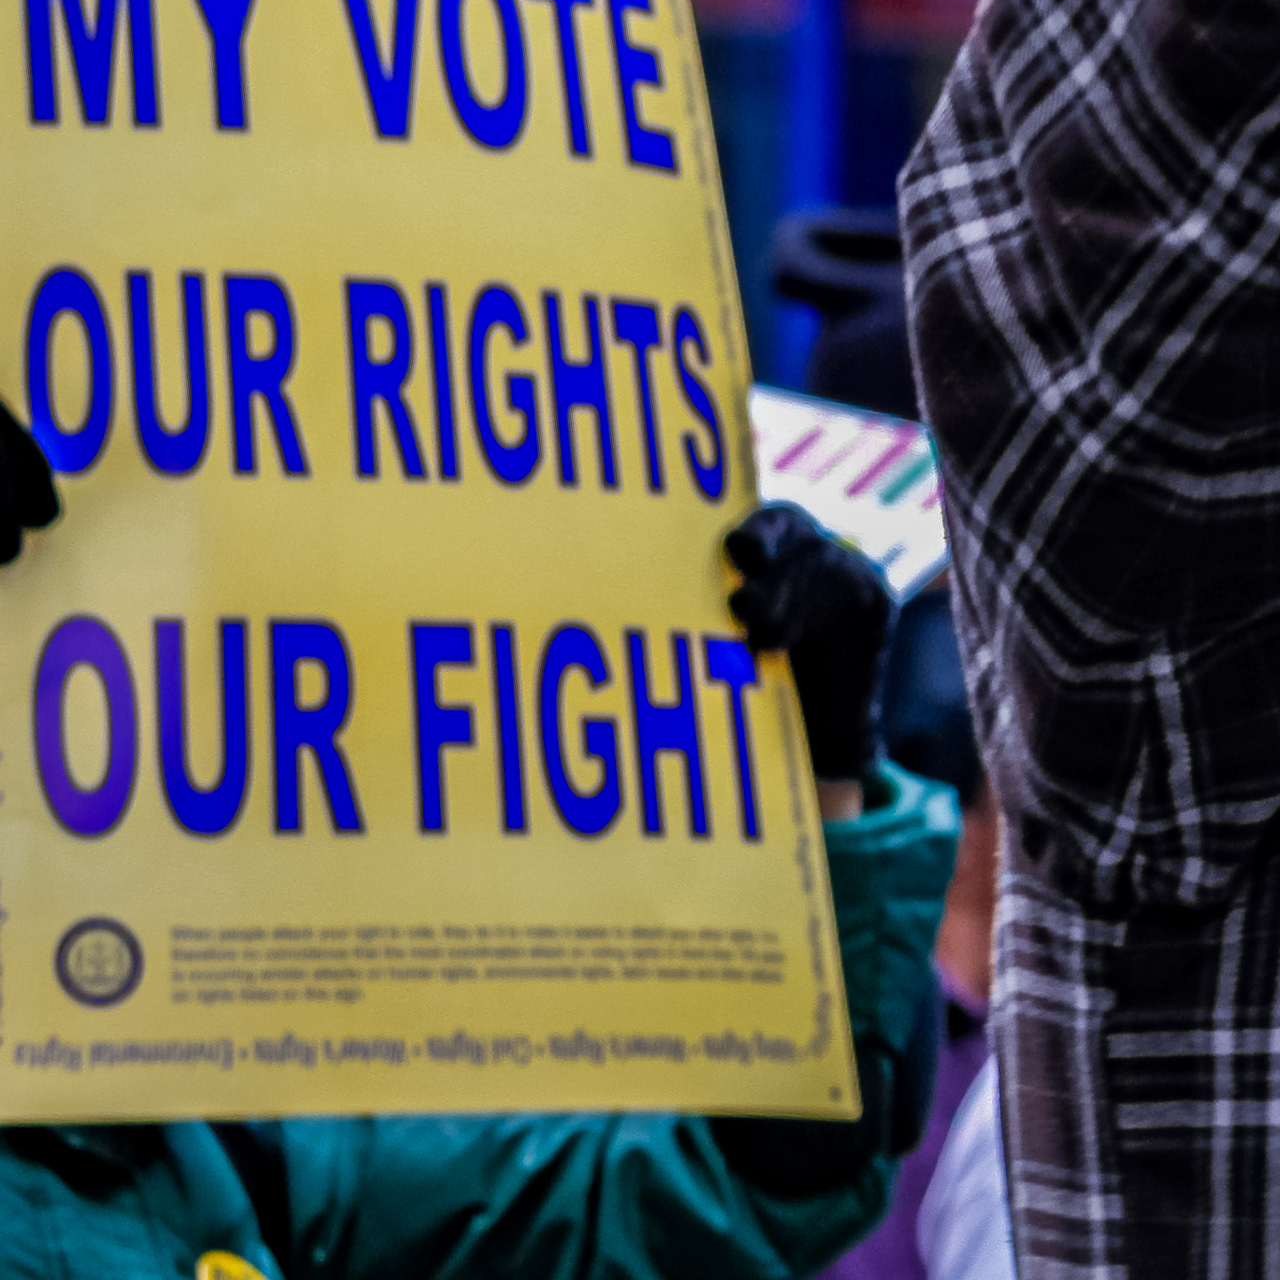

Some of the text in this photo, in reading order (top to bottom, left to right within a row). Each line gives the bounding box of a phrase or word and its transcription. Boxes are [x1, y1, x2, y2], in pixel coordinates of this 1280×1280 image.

[23, 263, 311, 479] OUR
[343, 276, 729, 506] RIGHTS
[31, 613, 763, 843] OUR FIGHT
